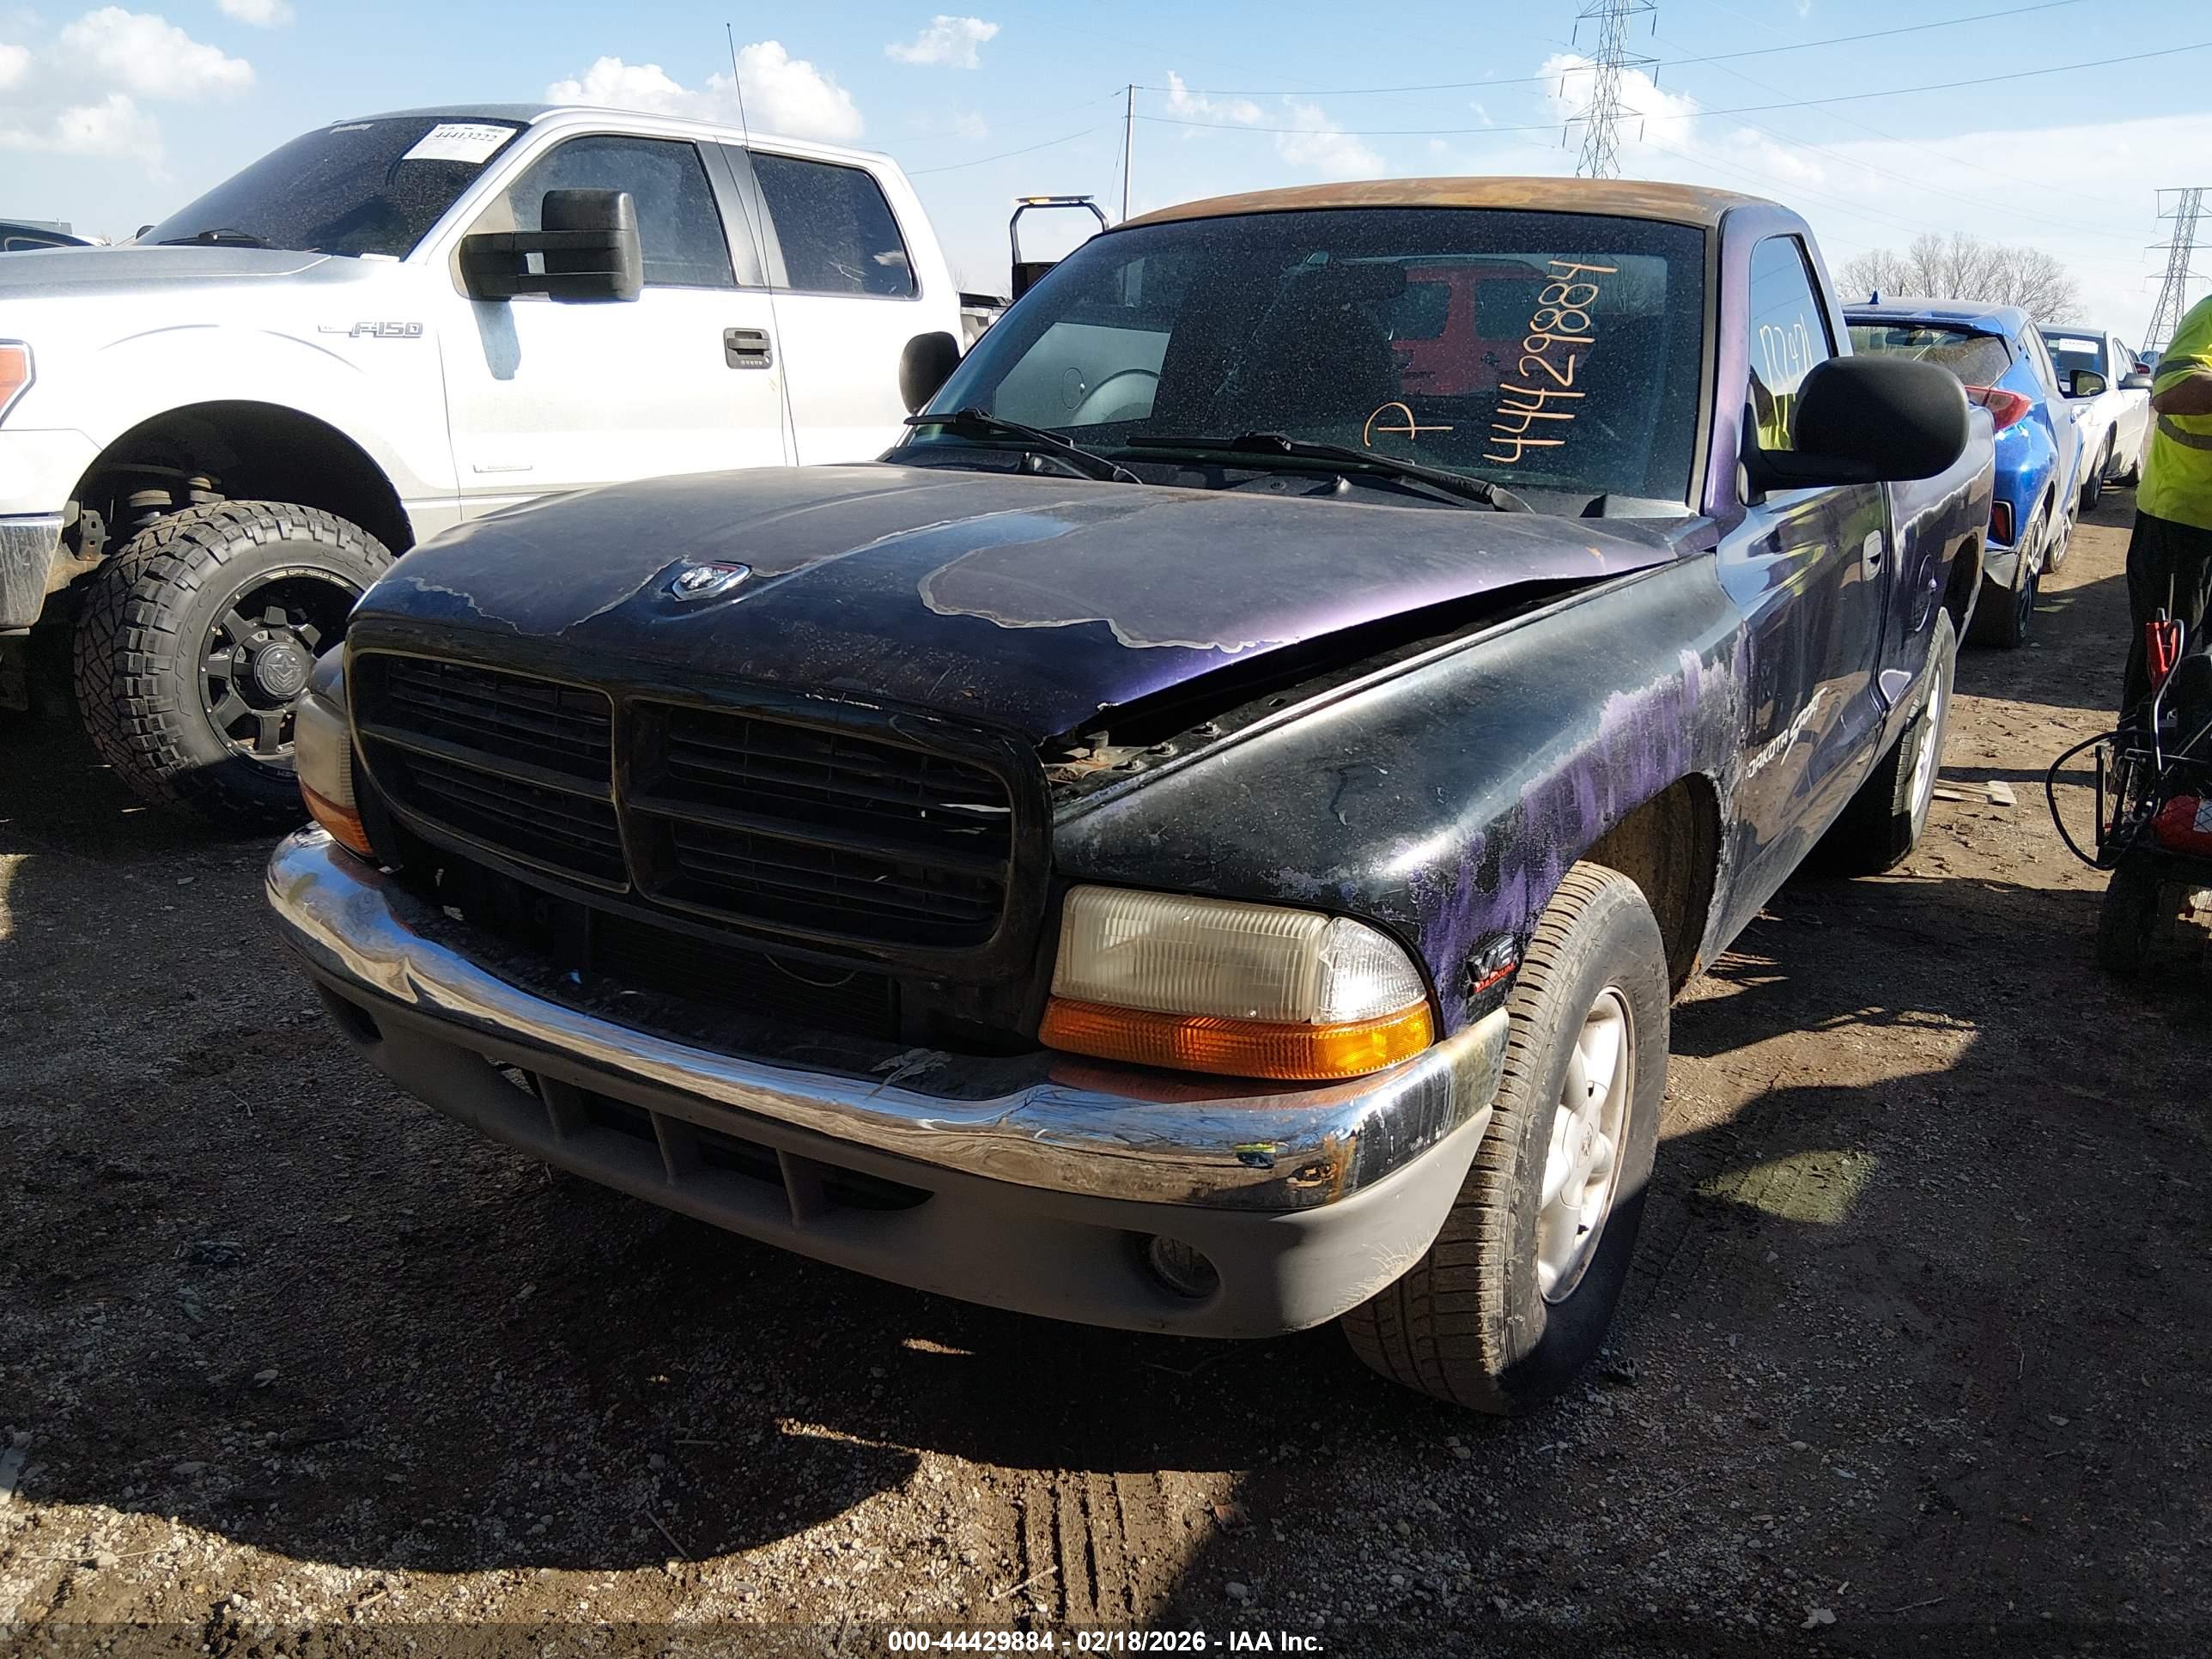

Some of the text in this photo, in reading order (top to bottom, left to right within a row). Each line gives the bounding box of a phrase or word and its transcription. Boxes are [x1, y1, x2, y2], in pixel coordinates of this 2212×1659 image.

[353, 321, 423, 336] F-150
[1482, 259, 1618, 464] 44429884
[288, 569, 330, 579] OFF-ROAD
